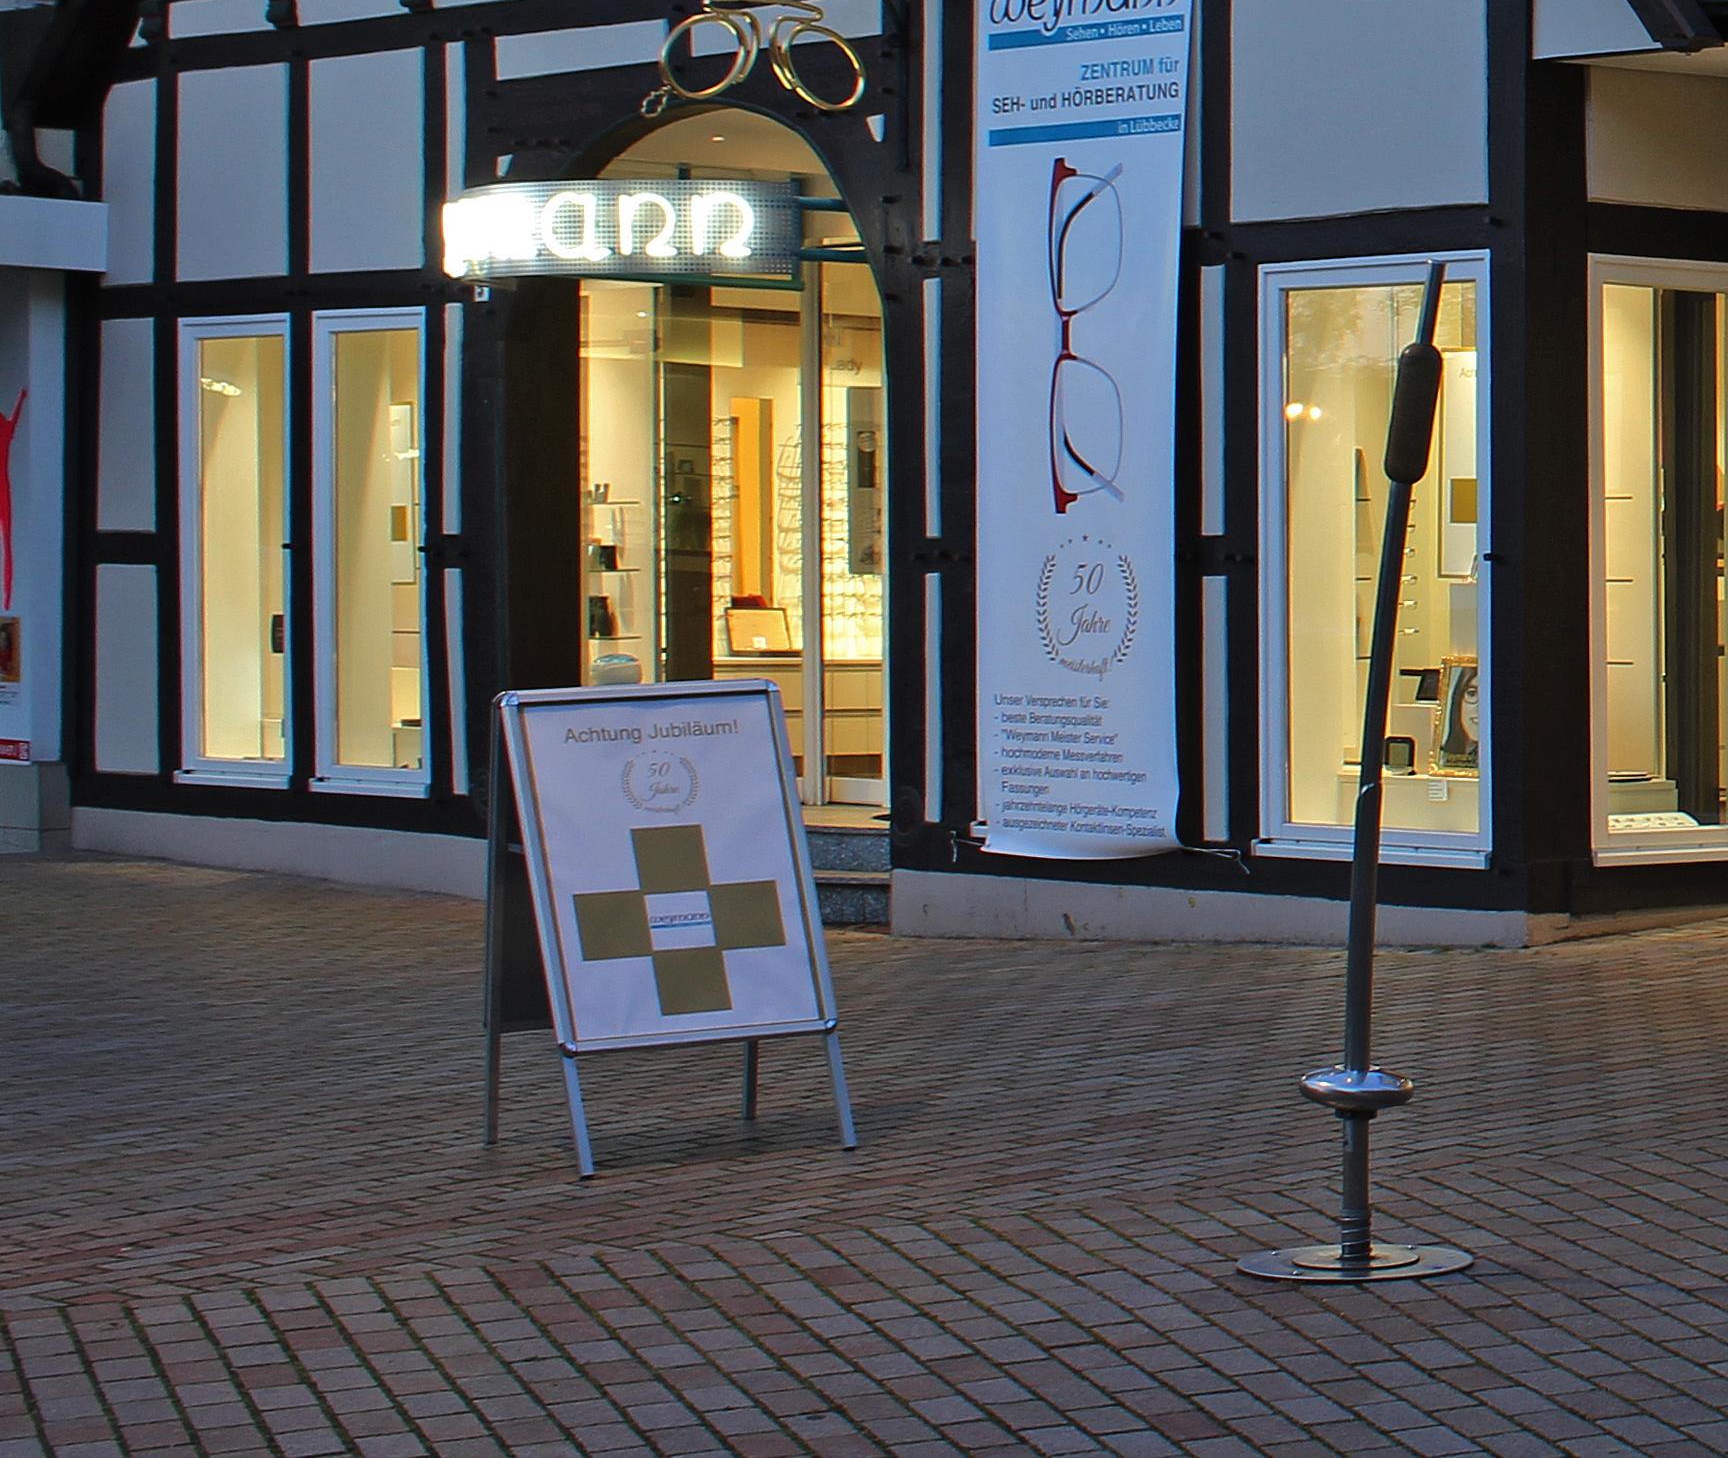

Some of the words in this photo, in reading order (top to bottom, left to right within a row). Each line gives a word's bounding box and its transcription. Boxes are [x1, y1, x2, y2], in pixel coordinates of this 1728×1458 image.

[1066, 26, 1099, 40] Sehen
[1108, 22, 1140, 36] Hören
[1149, 18, 1181, 32] Leben
[1081, 58, 1154, 81] ZENTRUM
[1159, 56, 1180, 73] für
[992, 97, 1025, 114] SEH-
[1030, 93, 1057, 111] und
[1061, 81, 1180, 108] HÖRBERATUNG
[1118, 122, 1128, 133] in
[1130, 117, 1180, 133] Lübbecke
[1069, 563, 1104, 595] 50
[1057, 603, 1111, 646] Jahre
[564, 726, 642, 744] Achtung
[647, 719, 739, 740] Jubiläum!
[648, 761, 671, 778] 50
